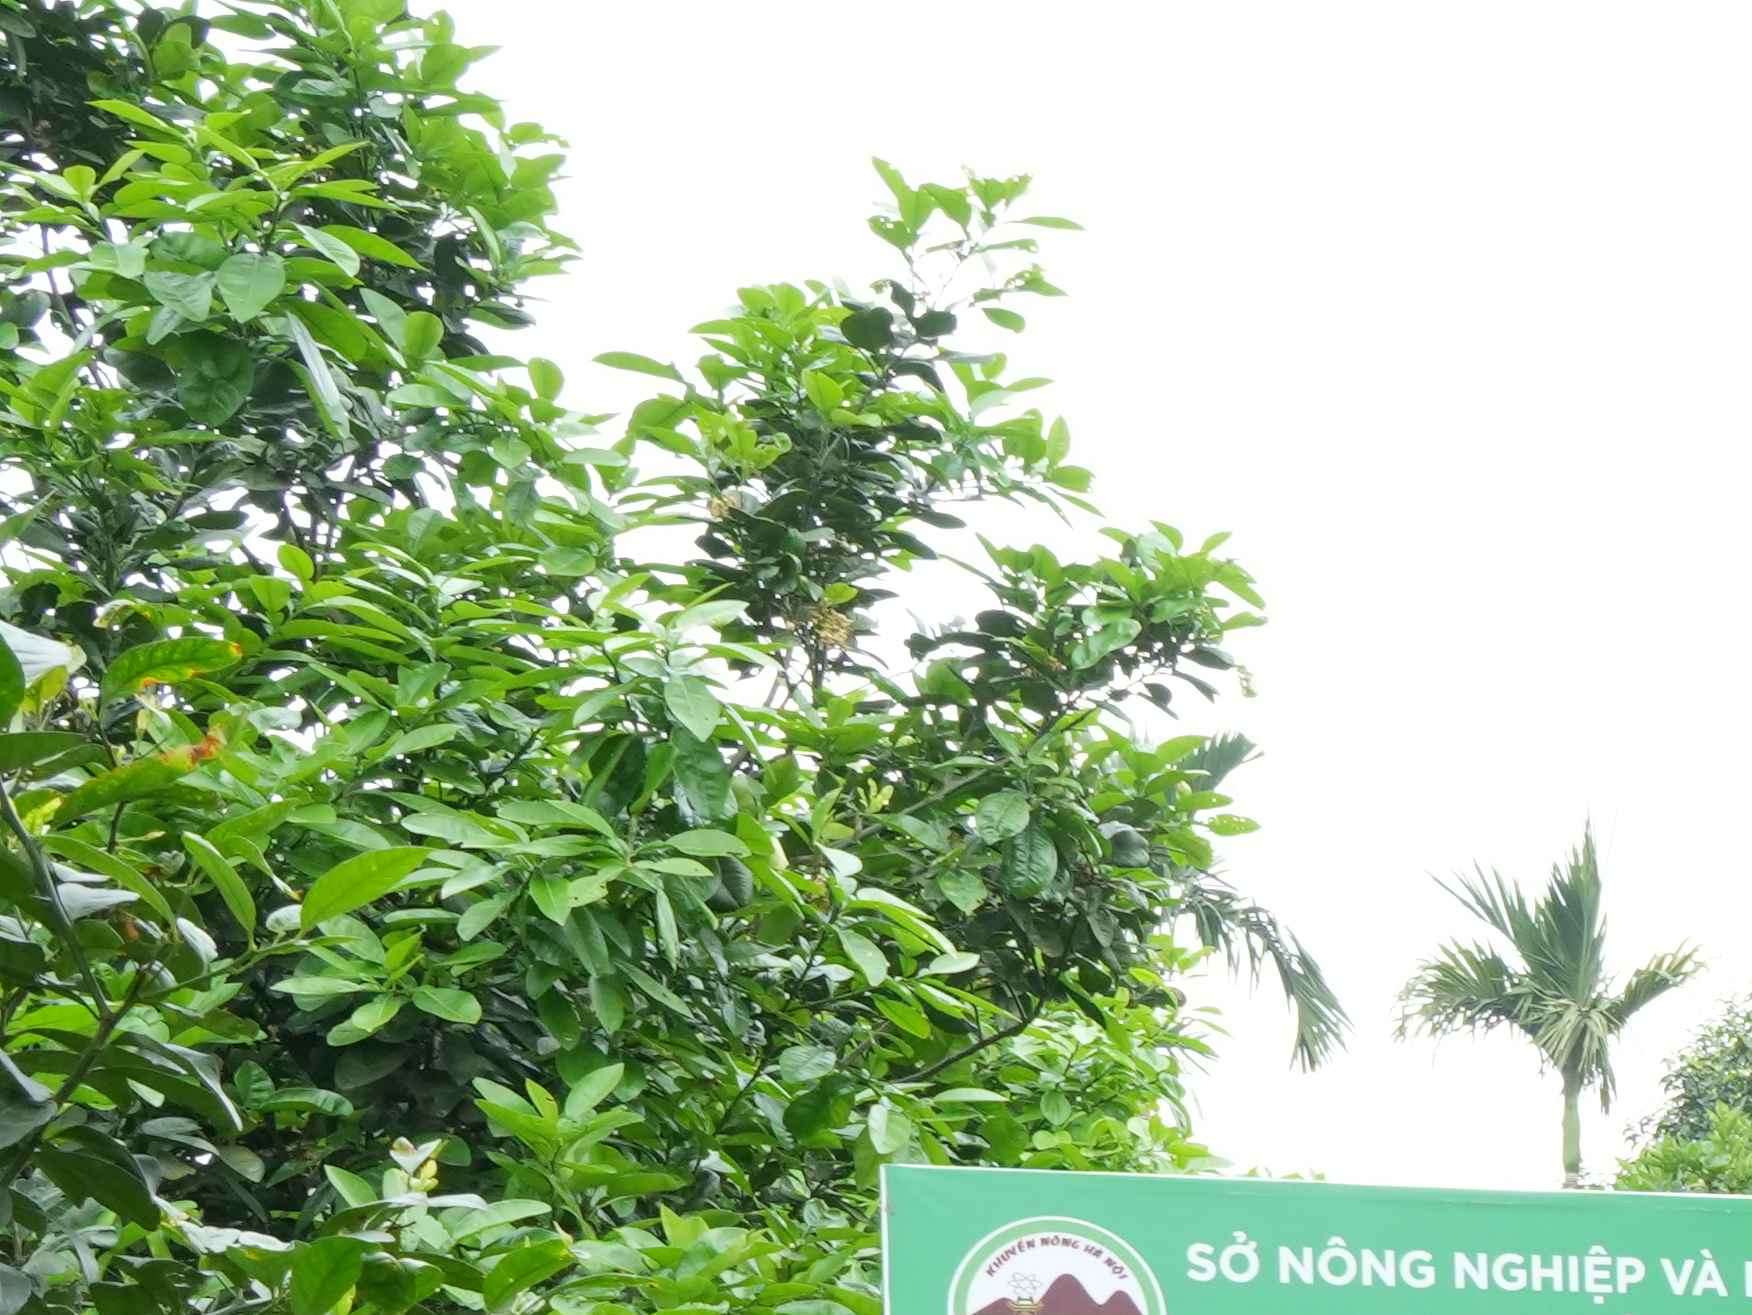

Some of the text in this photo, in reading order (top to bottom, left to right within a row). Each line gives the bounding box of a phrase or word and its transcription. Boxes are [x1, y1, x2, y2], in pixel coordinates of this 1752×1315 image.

[1187, 1231, 1260, 1282] SỞ
[1279, 1236, 1435, 1288] NÔNG
[1454, 1245, 1646, 1304] NGHIỆP
[1660, 1249, 1728, 1296] VÀ
